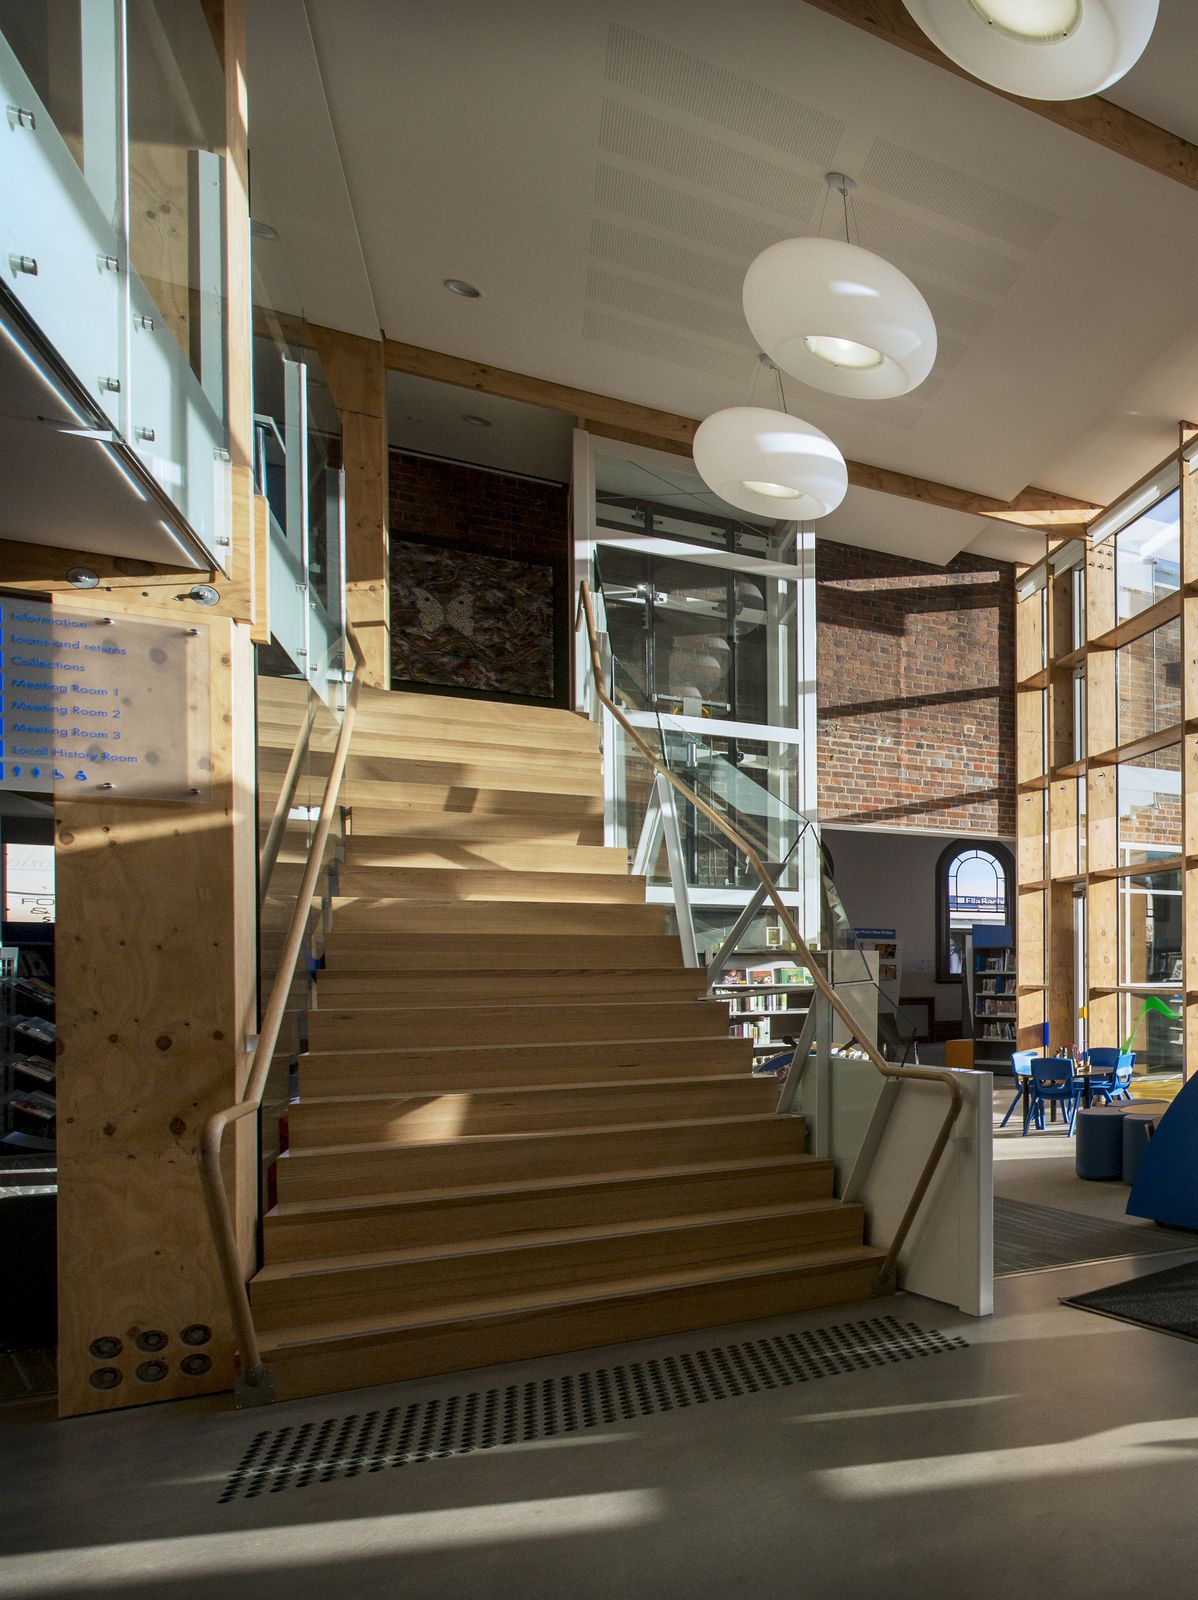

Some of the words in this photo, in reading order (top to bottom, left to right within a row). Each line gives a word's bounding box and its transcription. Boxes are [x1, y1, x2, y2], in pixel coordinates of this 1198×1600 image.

[53, 640, 80, 650] and
[85, 643, 127, 655] returns
[12, 655, 85, 671] Collections
[13, 680, 67, 694] Meeting
[72, 684, 107, 696] Room
[13, 701, 68, 716] Meeting
[73, 706, 108, 717] Room
[113, 709, 120, 719] 2
[14, 723, 68, 738] Meeting
[72, 727, 108, 739] Room
[113, 731, 120, 740] 3
[13, 745, 48, 757] Local
[52, 748, 98, 762] History
[102, 751, 138, 762] Room
